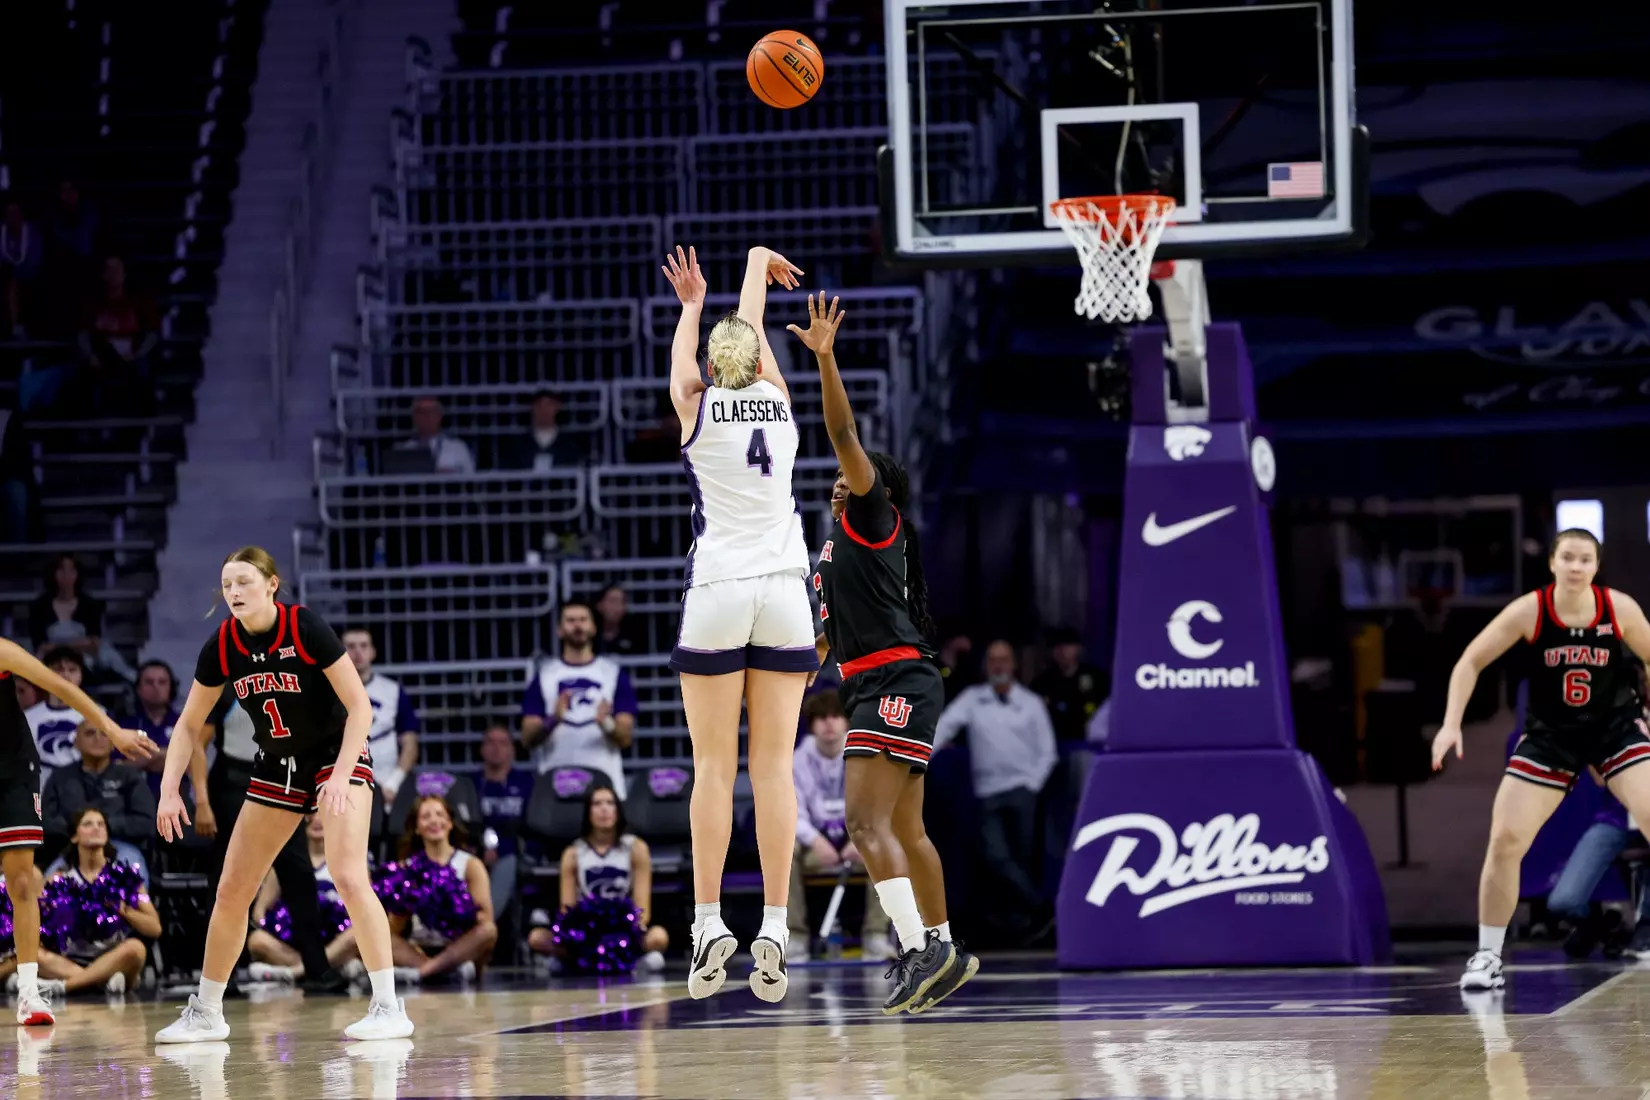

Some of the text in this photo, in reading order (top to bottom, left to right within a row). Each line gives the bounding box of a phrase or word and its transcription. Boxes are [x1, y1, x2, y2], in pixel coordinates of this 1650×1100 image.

[783, 52, 816, 87] ELITE
[711, 400, 788, 423] CLAESSENS
[746, 427, 774, 477] 4
[1544, 645, 1610, 667] UTAH
[233, 672, 301, 699] UTAH
[1563, 669, 1592, 707] 6
[262, 698, 291, 738] 1
[1073, 813, 1329, 907] Dillons
